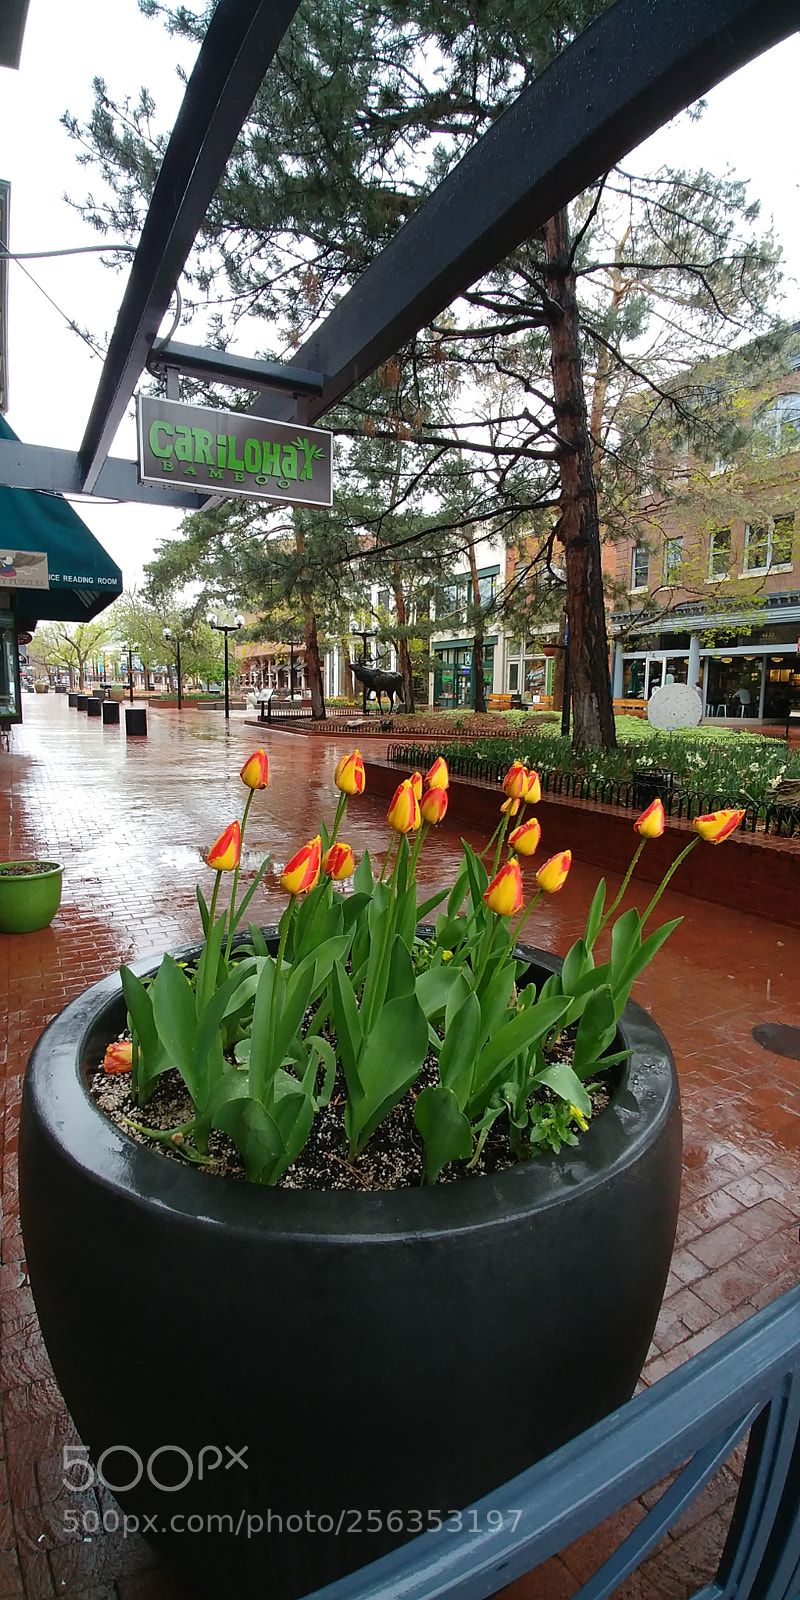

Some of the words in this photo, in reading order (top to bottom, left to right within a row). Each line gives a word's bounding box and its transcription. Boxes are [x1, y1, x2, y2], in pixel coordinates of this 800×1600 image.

[162, 460, 291, 489] BAMBOO
[9, 578, 45, 587] PUZZLES
[63, 574, 94, 584] READING
[97, 577, 118, 585] ROOM
